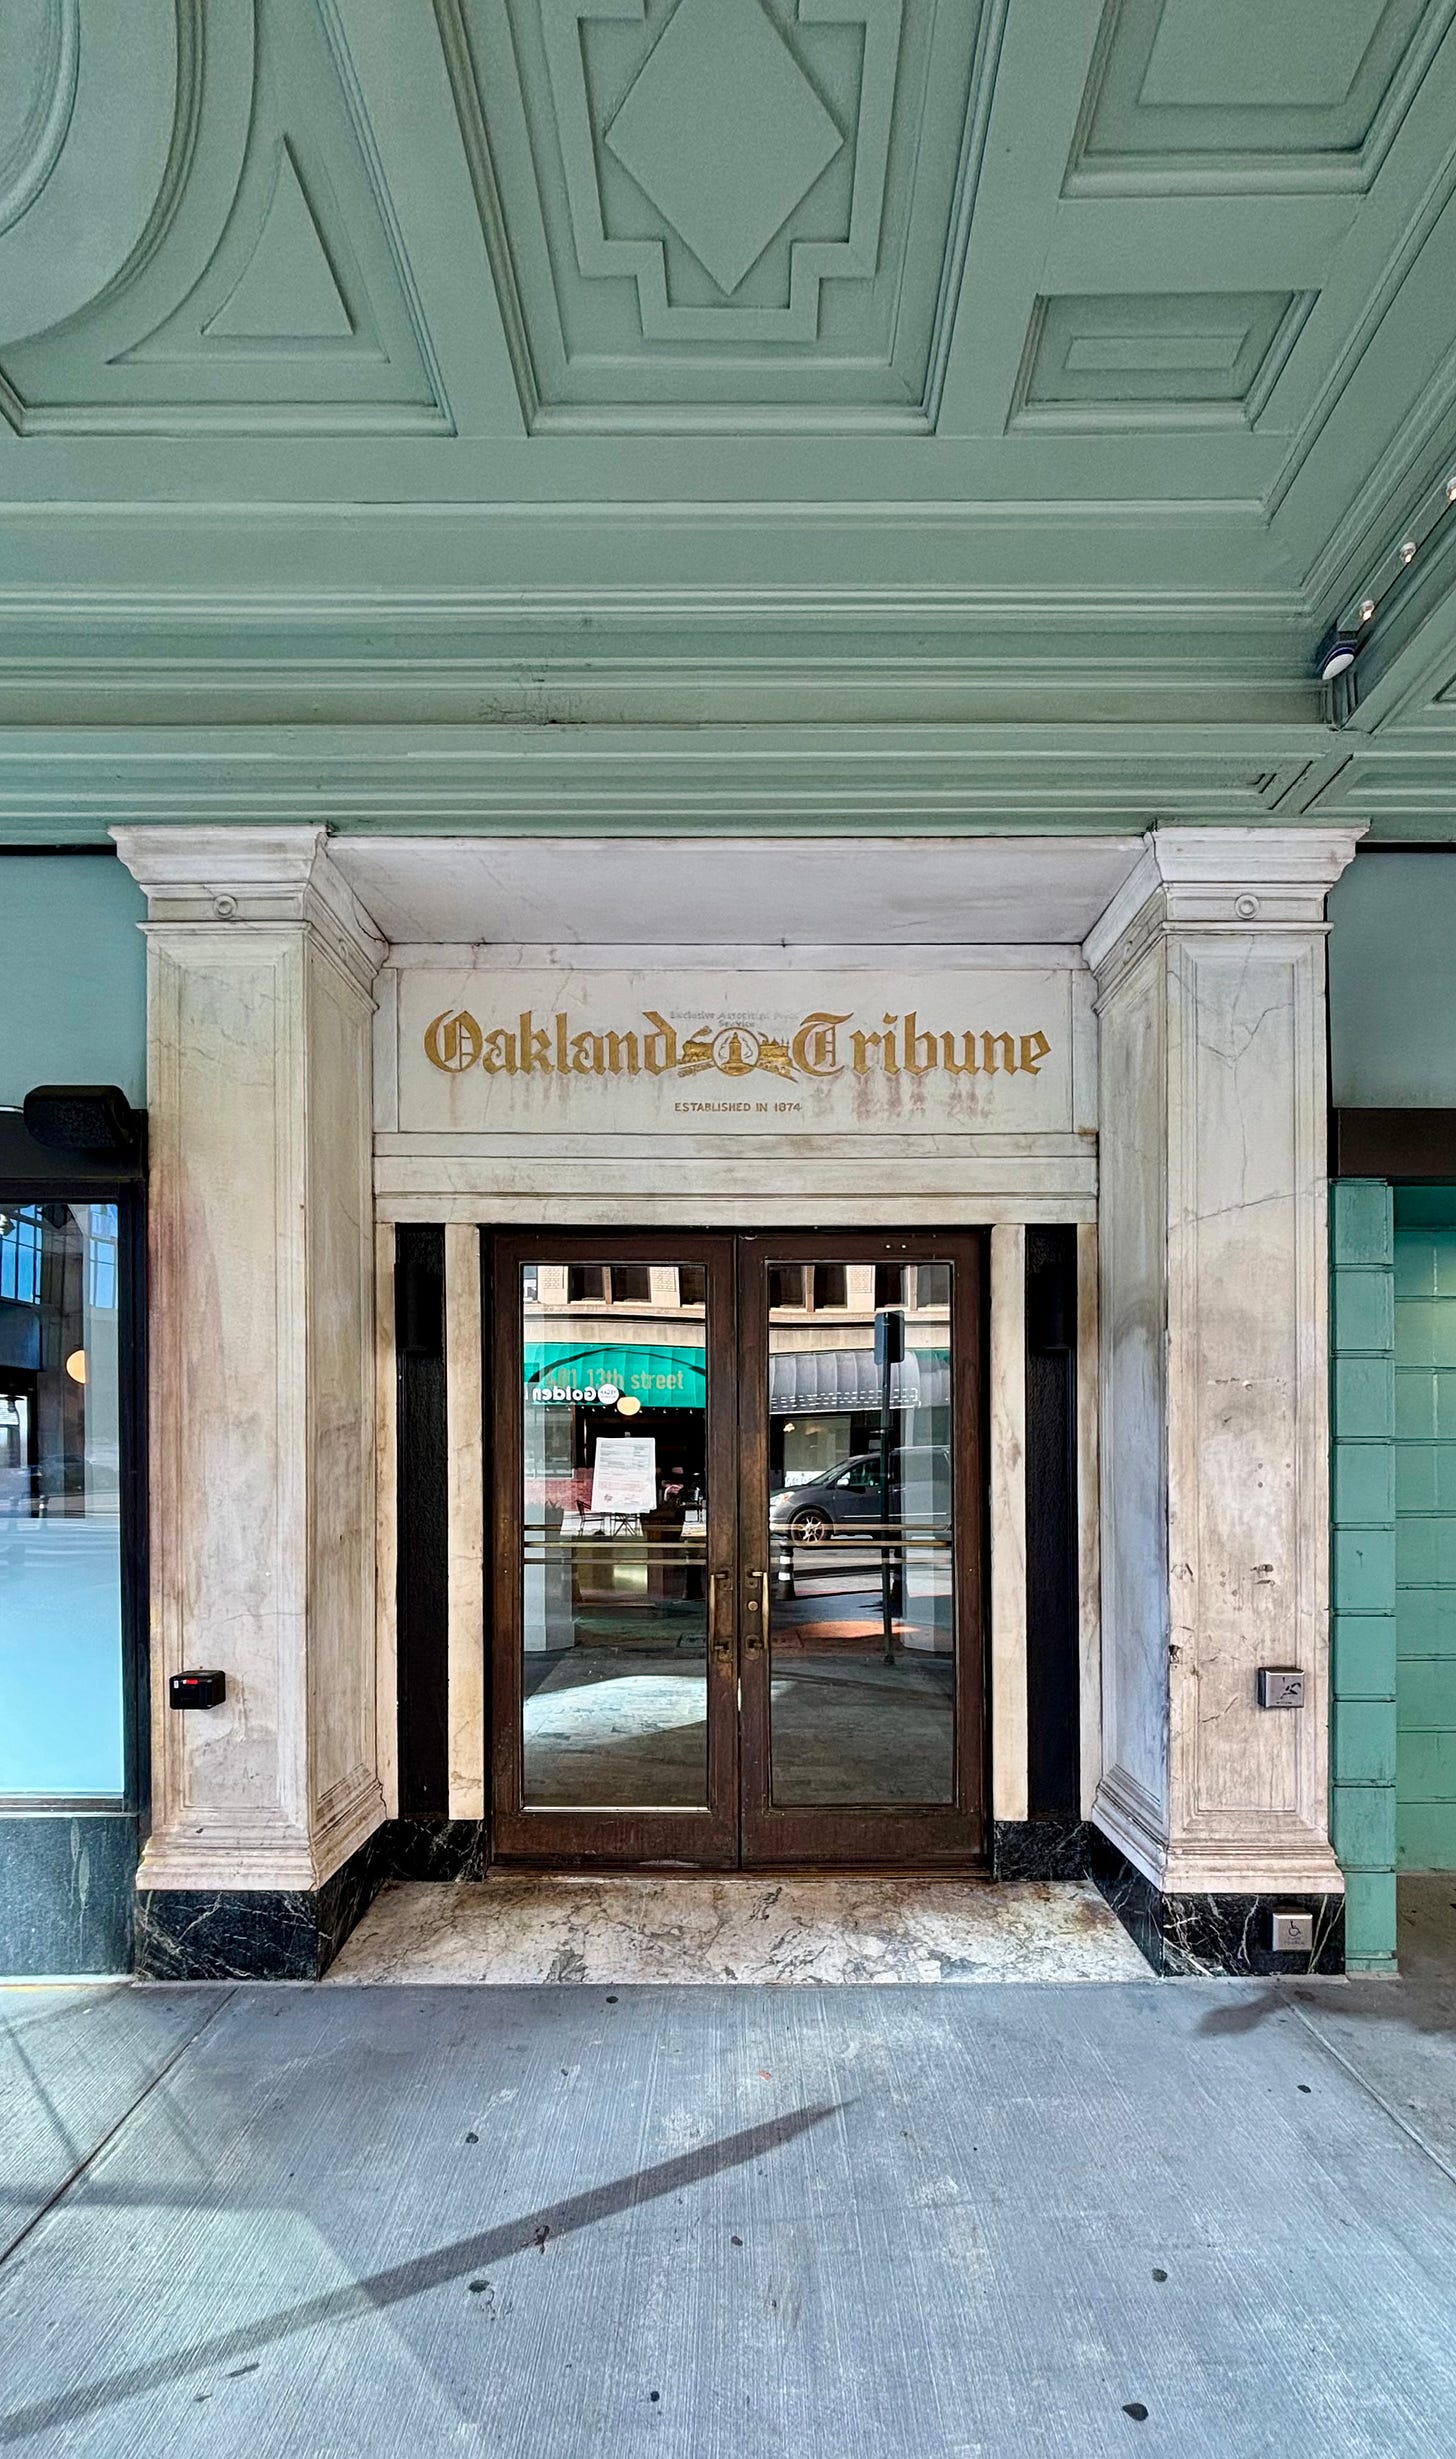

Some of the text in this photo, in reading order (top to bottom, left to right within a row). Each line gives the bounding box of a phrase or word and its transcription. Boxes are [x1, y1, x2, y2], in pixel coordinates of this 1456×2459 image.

[423, 1009, 1053, 1078] Oakland Tribune
[674, 1102, 801, 1112] ESTABLISHED IN 1874
[586, 1367, 625, 1391] 13th
[630, 1370, 684, 1390] street
